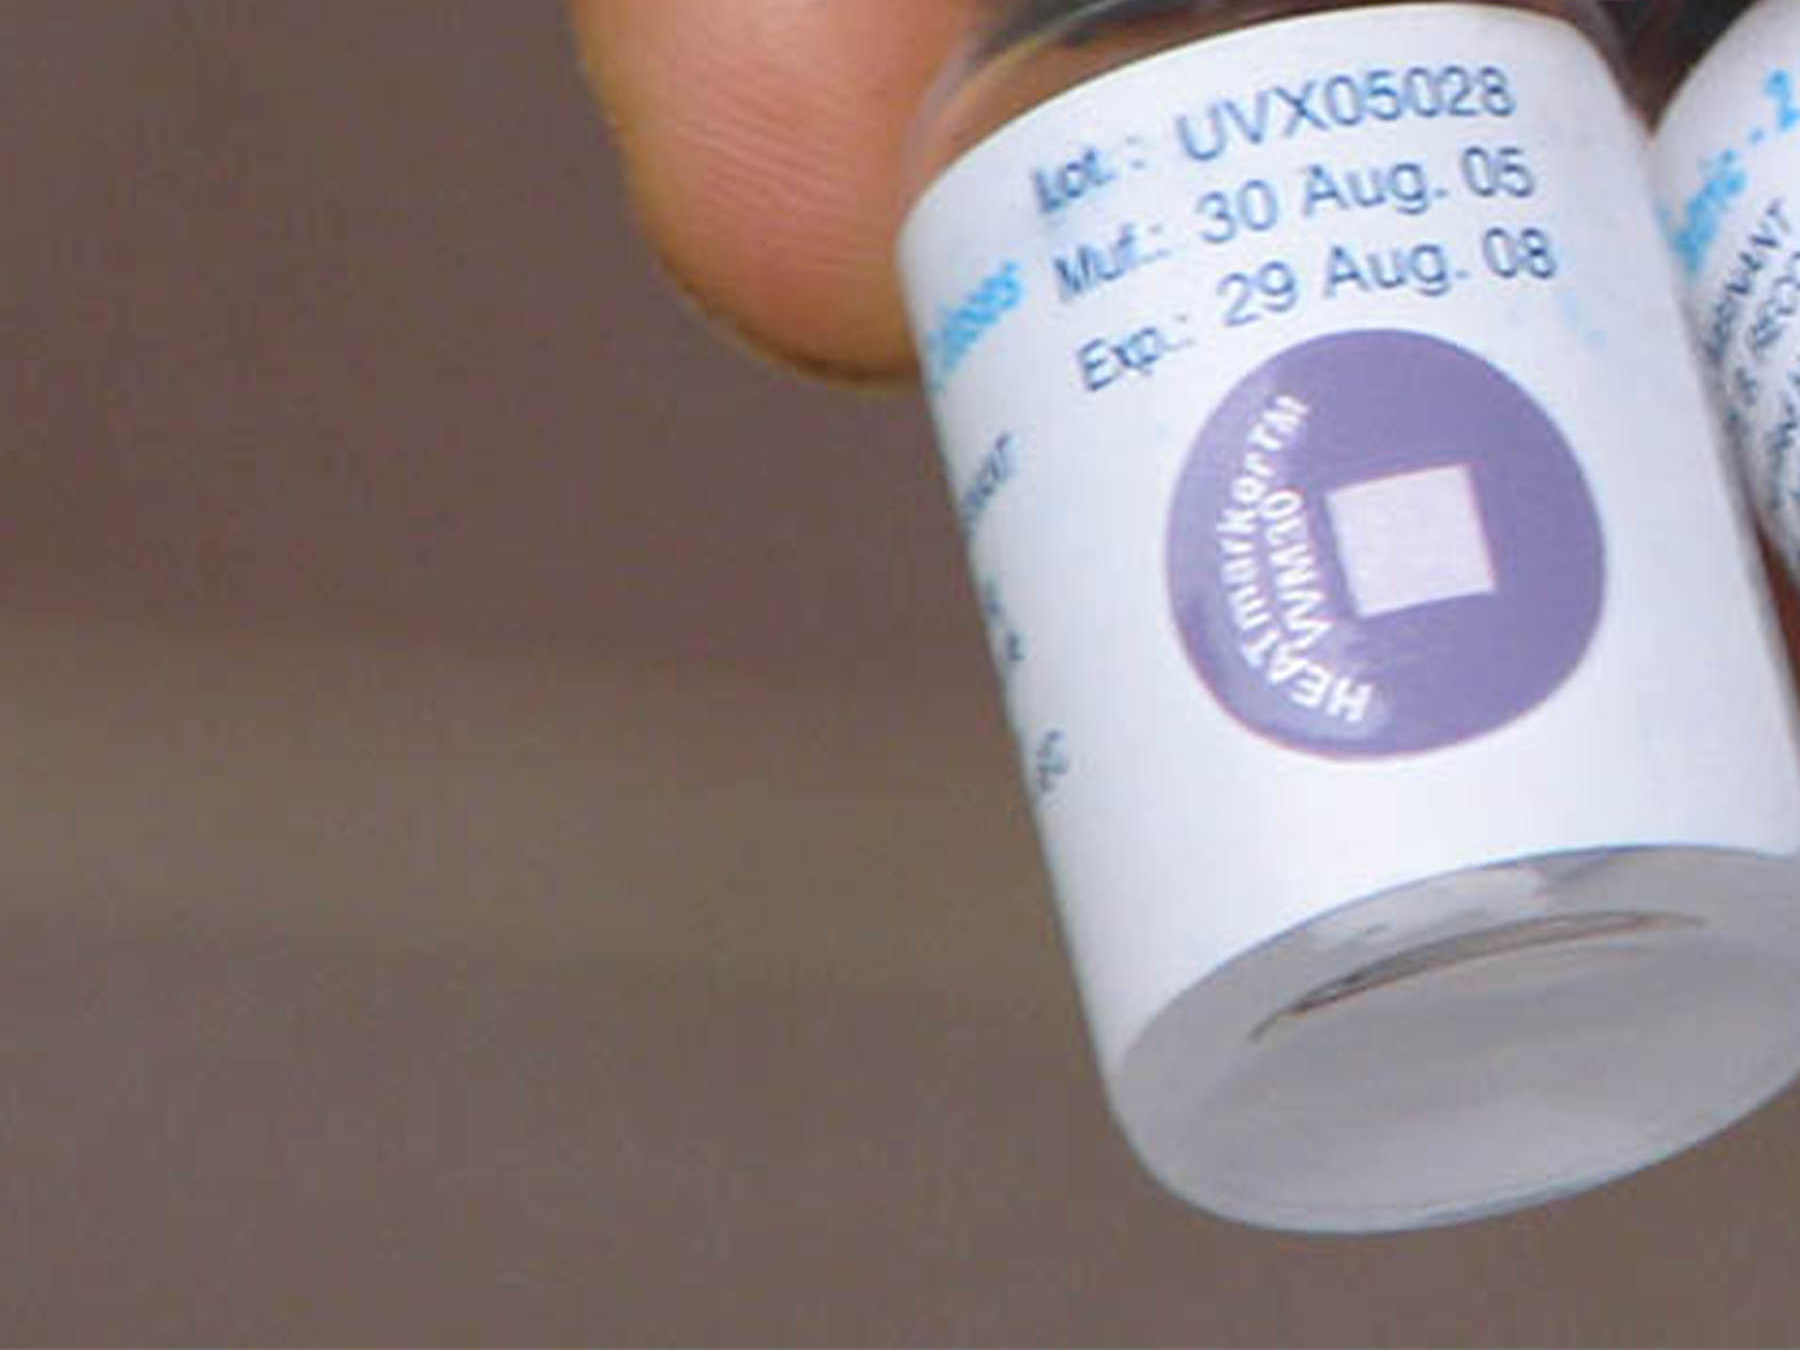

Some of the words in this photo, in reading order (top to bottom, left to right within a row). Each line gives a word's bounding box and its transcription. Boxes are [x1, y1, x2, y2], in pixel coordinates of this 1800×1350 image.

[1176, 64, 1517, 162] UVX05028
[1196, 178, 1280, 245] 30
[1303, 162, 1450, 216] Aug.
[1459, 146, 1537, 199] 05
[1217, 260, 1298, 328] 29
[1322, 242, 1470, 298] Aug.
[1482, 226, 1558, 280] 08
